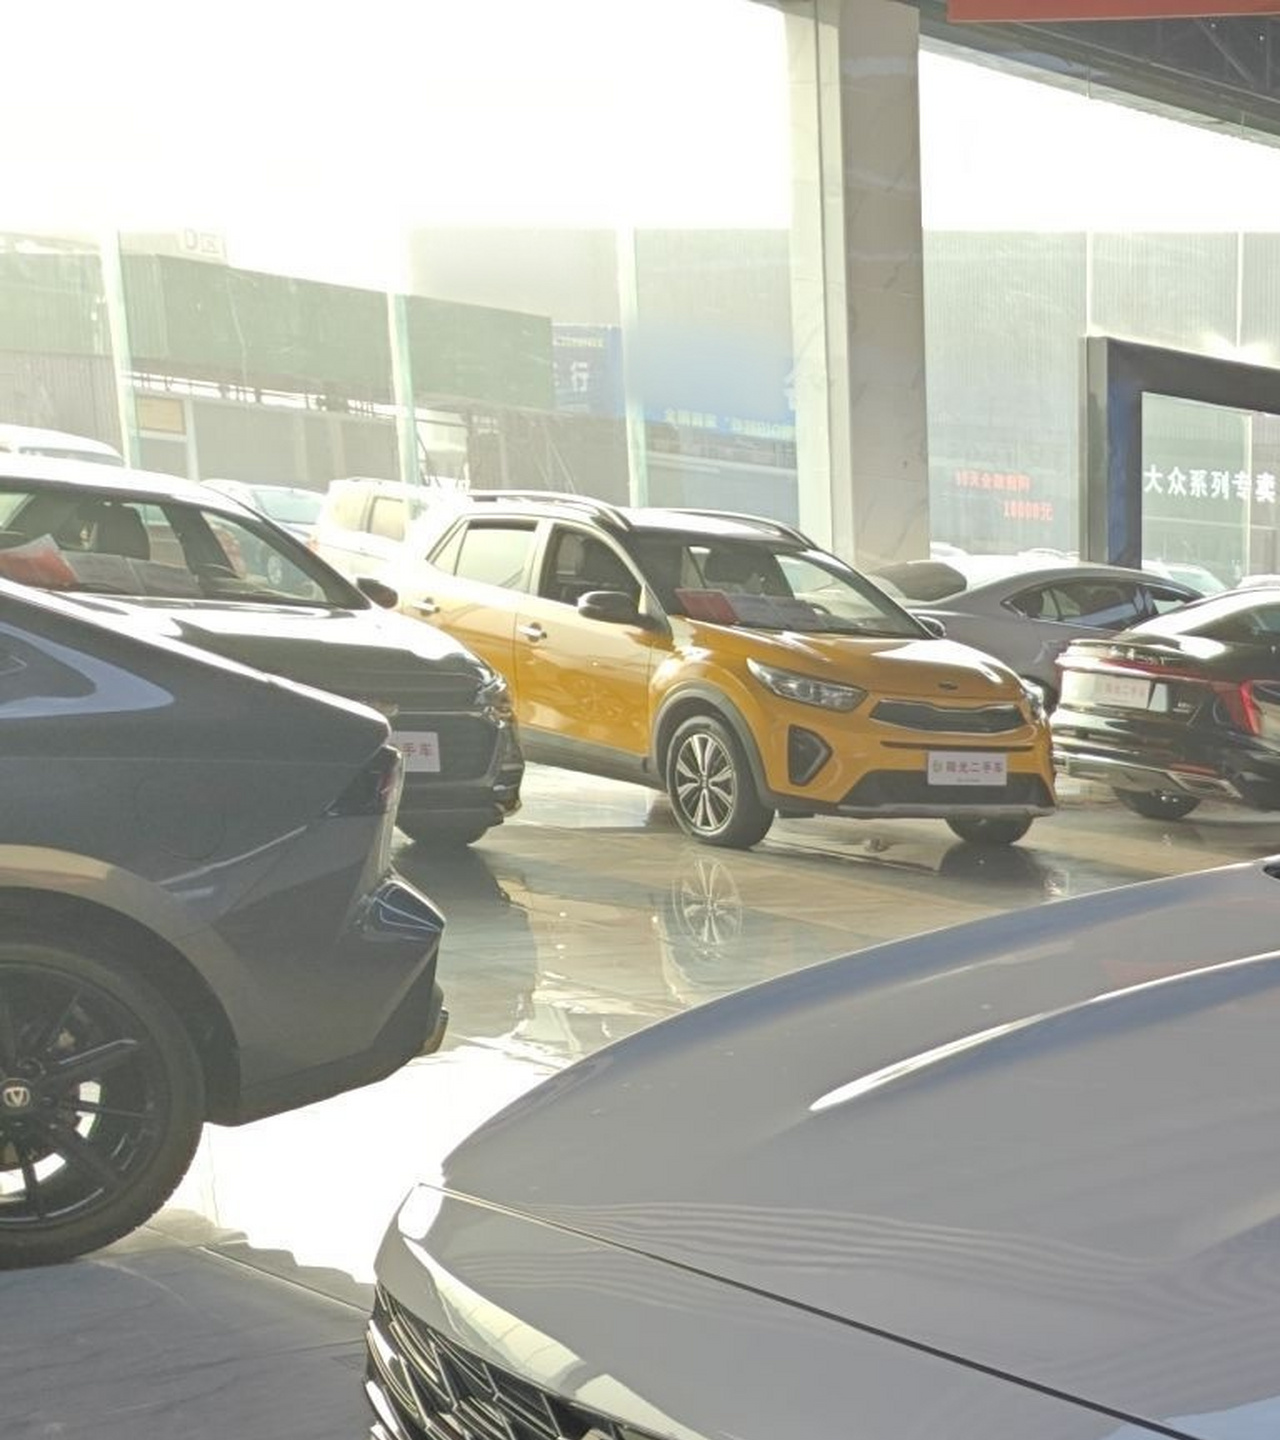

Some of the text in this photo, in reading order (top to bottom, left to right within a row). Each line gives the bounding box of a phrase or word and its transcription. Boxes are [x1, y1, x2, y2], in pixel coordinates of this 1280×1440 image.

[1143, 464, 1277, 503] 大众系列专卖
